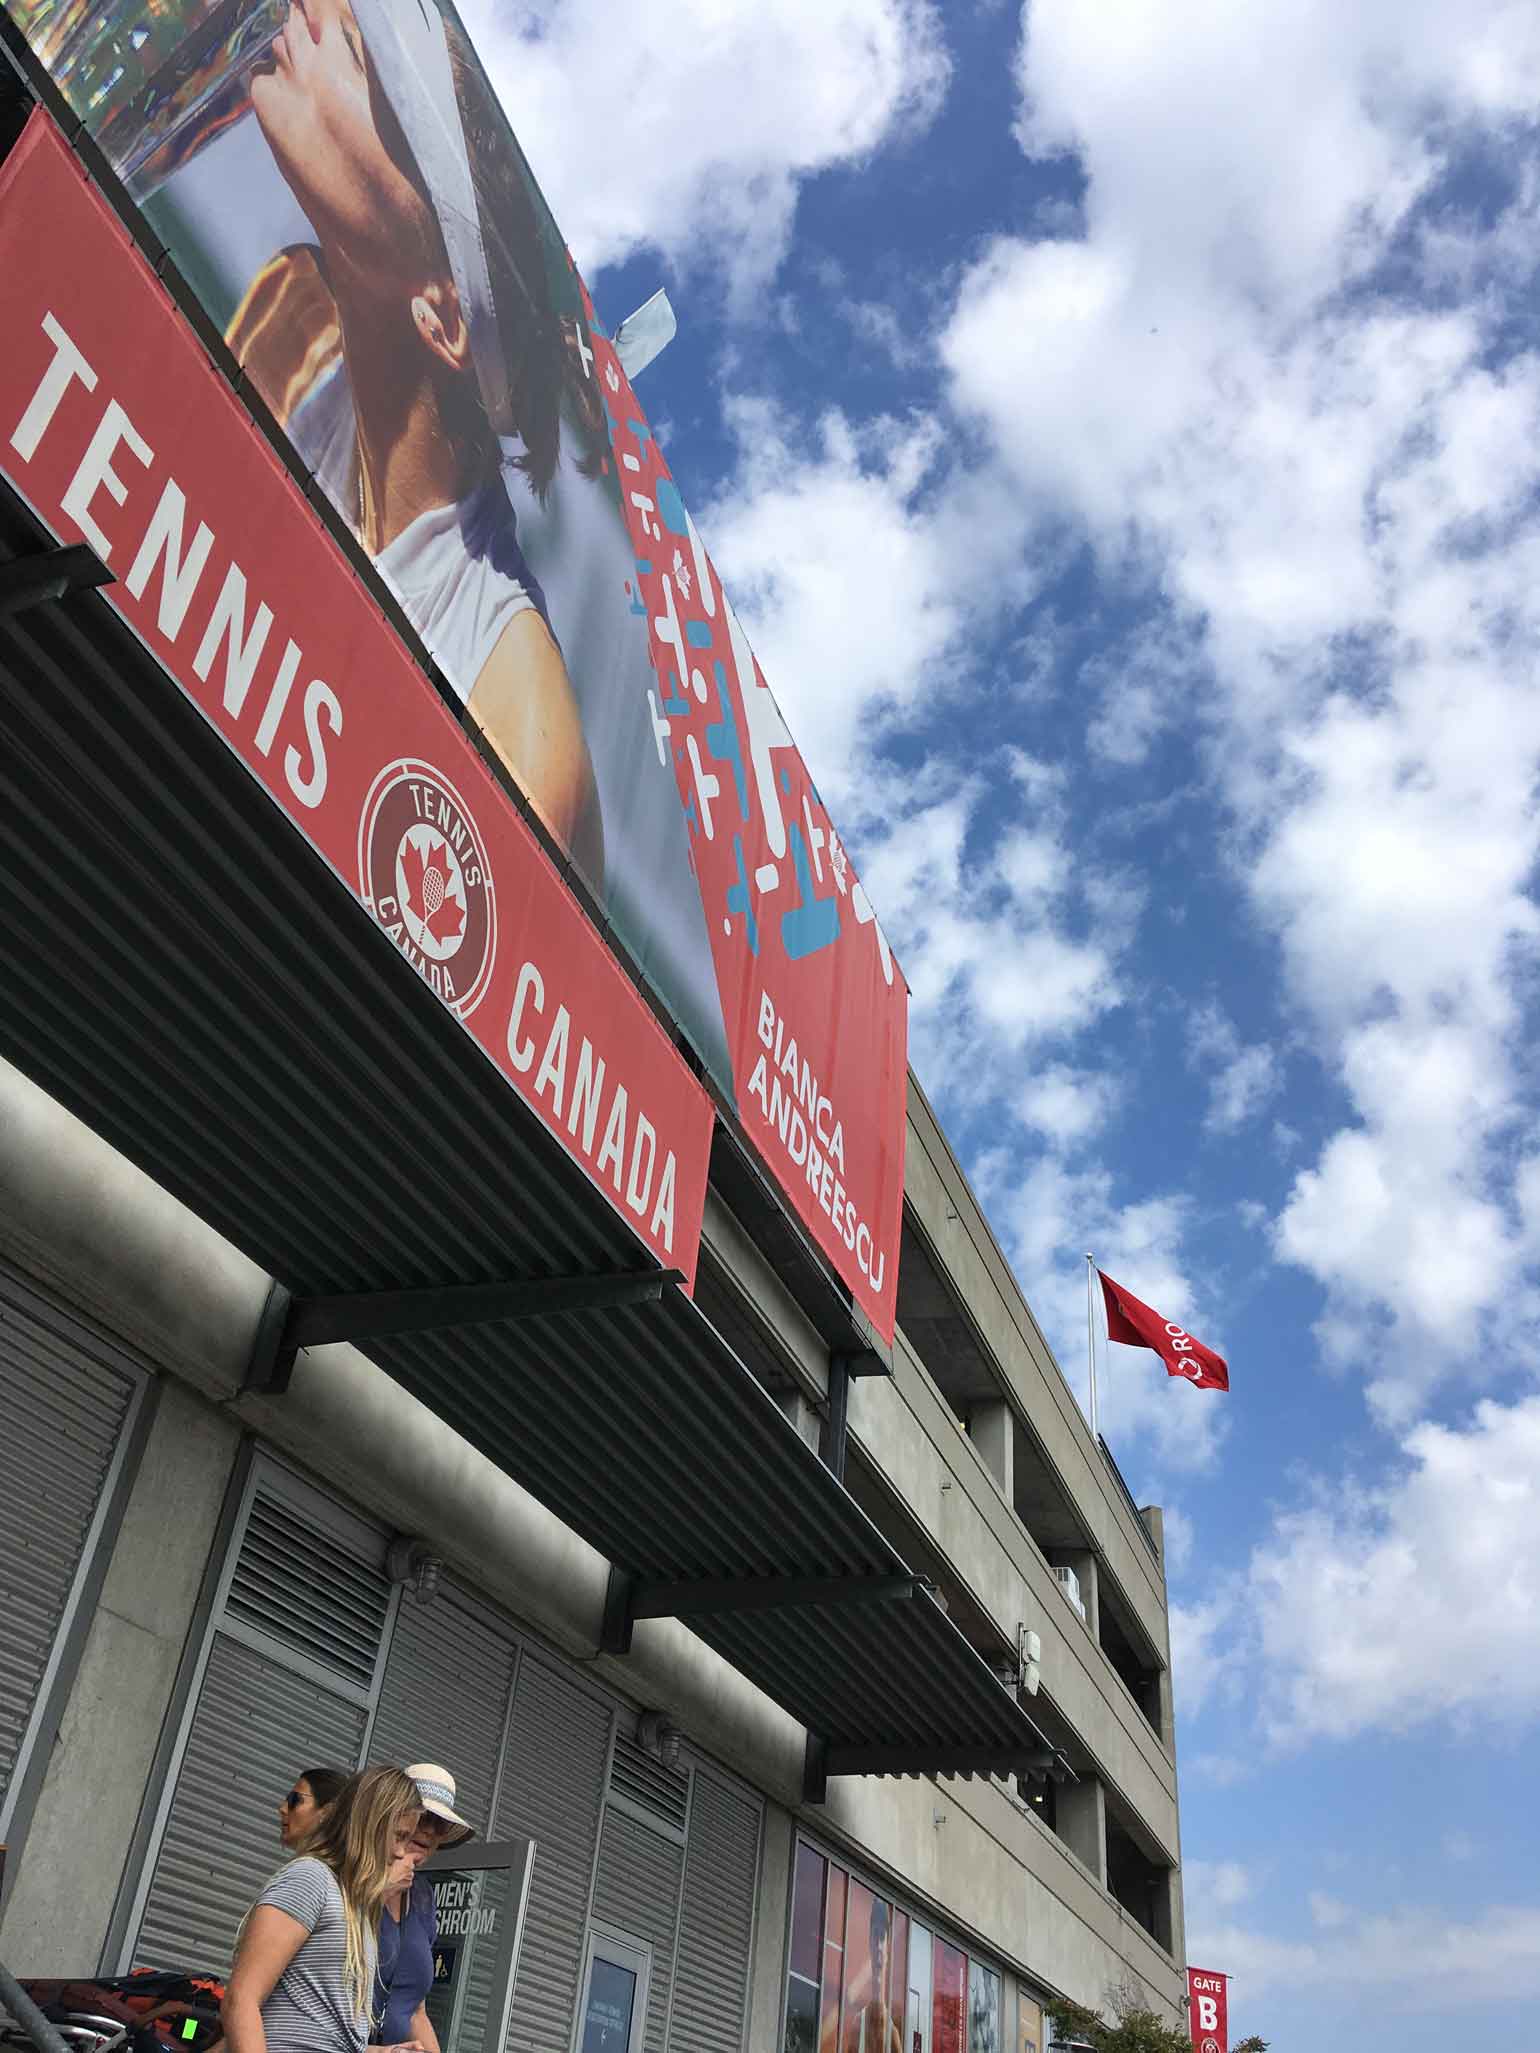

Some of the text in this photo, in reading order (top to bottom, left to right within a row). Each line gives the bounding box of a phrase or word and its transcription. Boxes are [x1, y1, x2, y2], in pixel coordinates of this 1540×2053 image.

[10, 311, 342, 808] TENNIS
[409, 784, 481, 887] TENNIS
[507, 962, 676, 1254] CANADA
[757, 989, 845, 1176] BIANCA
[748, 1054, 884, 1292] ANDREESCU
[434, 1882, 480, 1907] MEN'S
[435, 1909, 496, 1935] SHROOM
[1194, 1977, 1222, 1993] GATE
[1198, 1995, 1218, 2031] B
